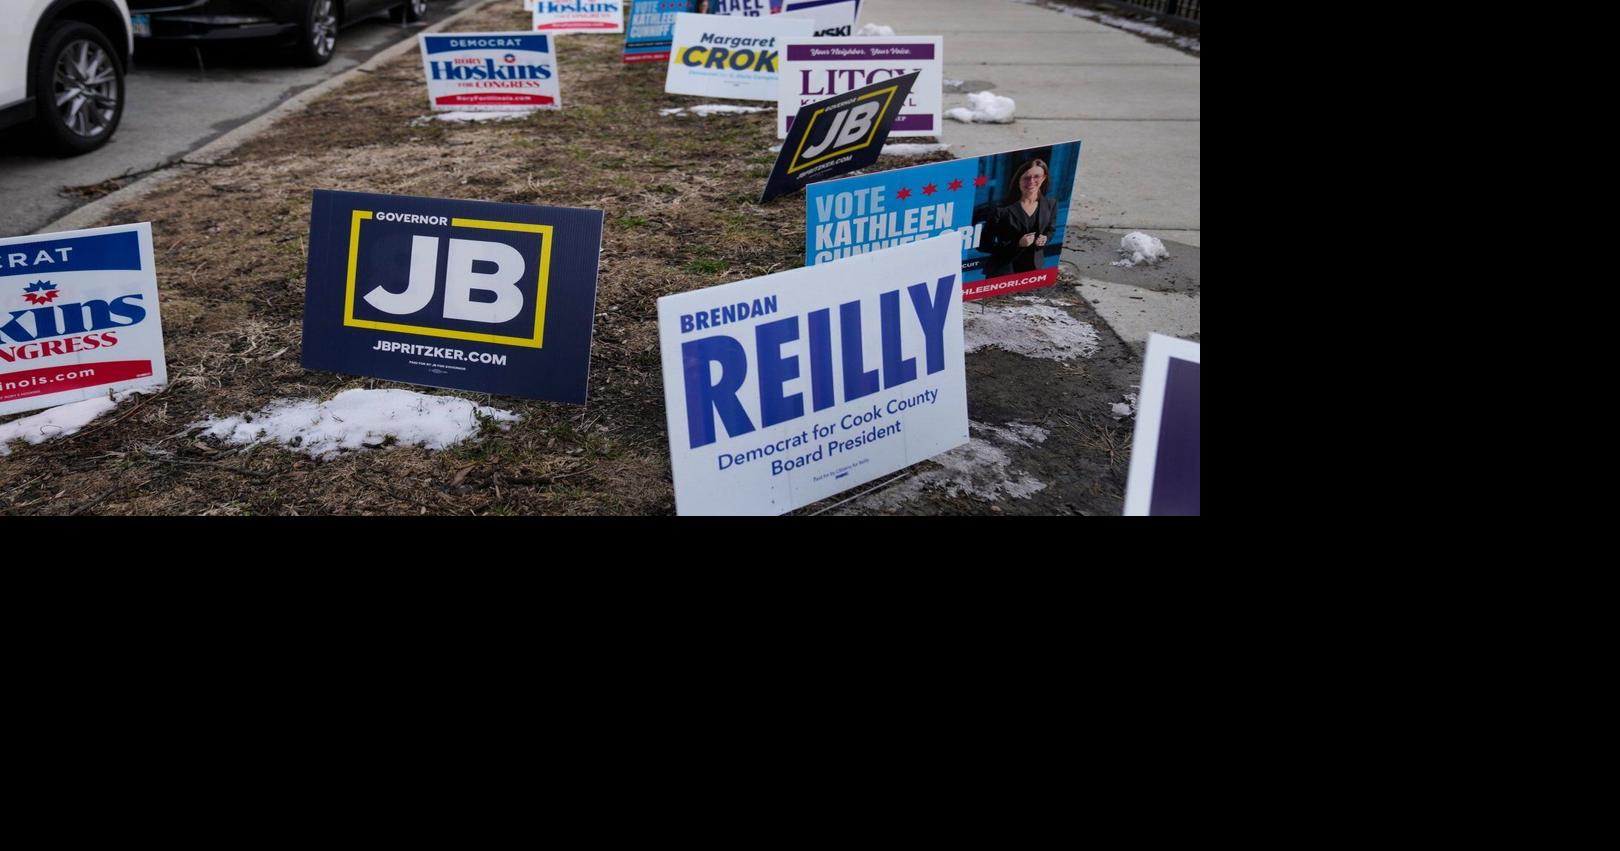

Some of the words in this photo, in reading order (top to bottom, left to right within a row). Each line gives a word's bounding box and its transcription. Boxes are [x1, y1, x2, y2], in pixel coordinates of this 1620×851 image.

[538, 0, 618, 14] Hoskins
[449, 38, 522, 48] DEMOCRAT
[700, 32, 776, 48] Margaret
[810, 48, 830, 56] Your
[870, 48, 890, 56] Your
[430, 58, 551, 80] Hoskins
[454, 57, 481, 65] RORY
[682, 45, 779, 73] CROK
[475, 80, 541, 88] CONGRESS
[800, 100, 880, 159] JB
[815, 185, 886, 222] VOTE
[375, 211, 448, 227] GOVERNOR
[815, 202, 954, 251] KATHLEEN
[363, 234, 526, 324] JB
[680, 295, 778, 334] BRENDAN
[372, 340, 507, 366] JBPRITZKER.COM
[681, 274, 956, 450] REILLY
[718, 429, 808, 471] Democrat
[812, 422, 836, 441] for
[841, 406, 882, 431] Cook
[886, 387, 939, 416] County
[771, 448, 823, 476] Board
[828, 419, 902, 457] President
